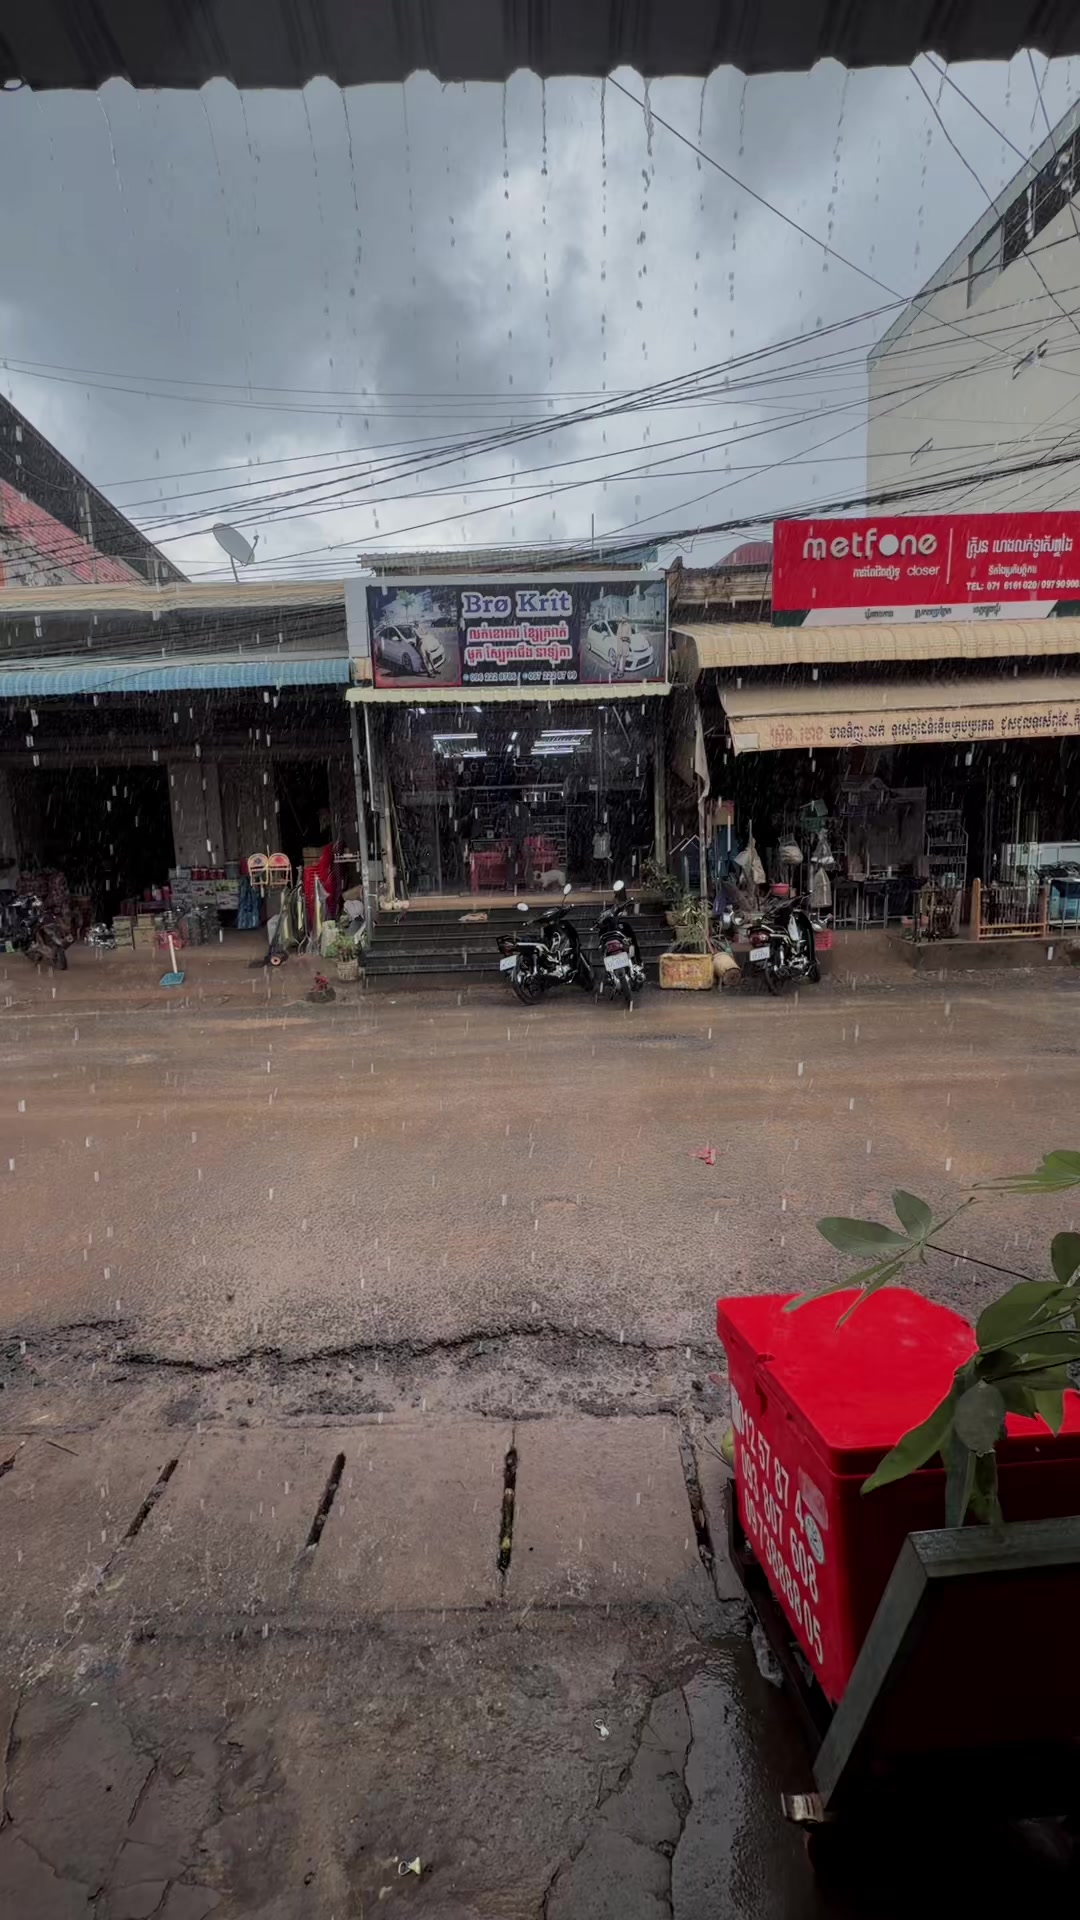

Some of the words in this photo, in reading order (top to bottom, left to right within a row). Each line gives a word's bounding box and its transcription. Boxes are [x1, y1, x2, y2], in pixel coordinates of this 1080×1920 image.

[803, 528, 937, 558] metfone
[906, 565, 940, 576] closer
[966, 582, 984, 591] TEL:
[484, 673, 498, 682] 222
[542, 671, 556, 680] 222
[738, 1400, 757, 1457] 012
[758, 1430, 771, 1479] 57
[774, 1457, 789, 1509] 87
[741, 1443, 759, 1501] 093
[762, 1482, 783, 1545] 807
[790, 1527, 818, 1603] 608
